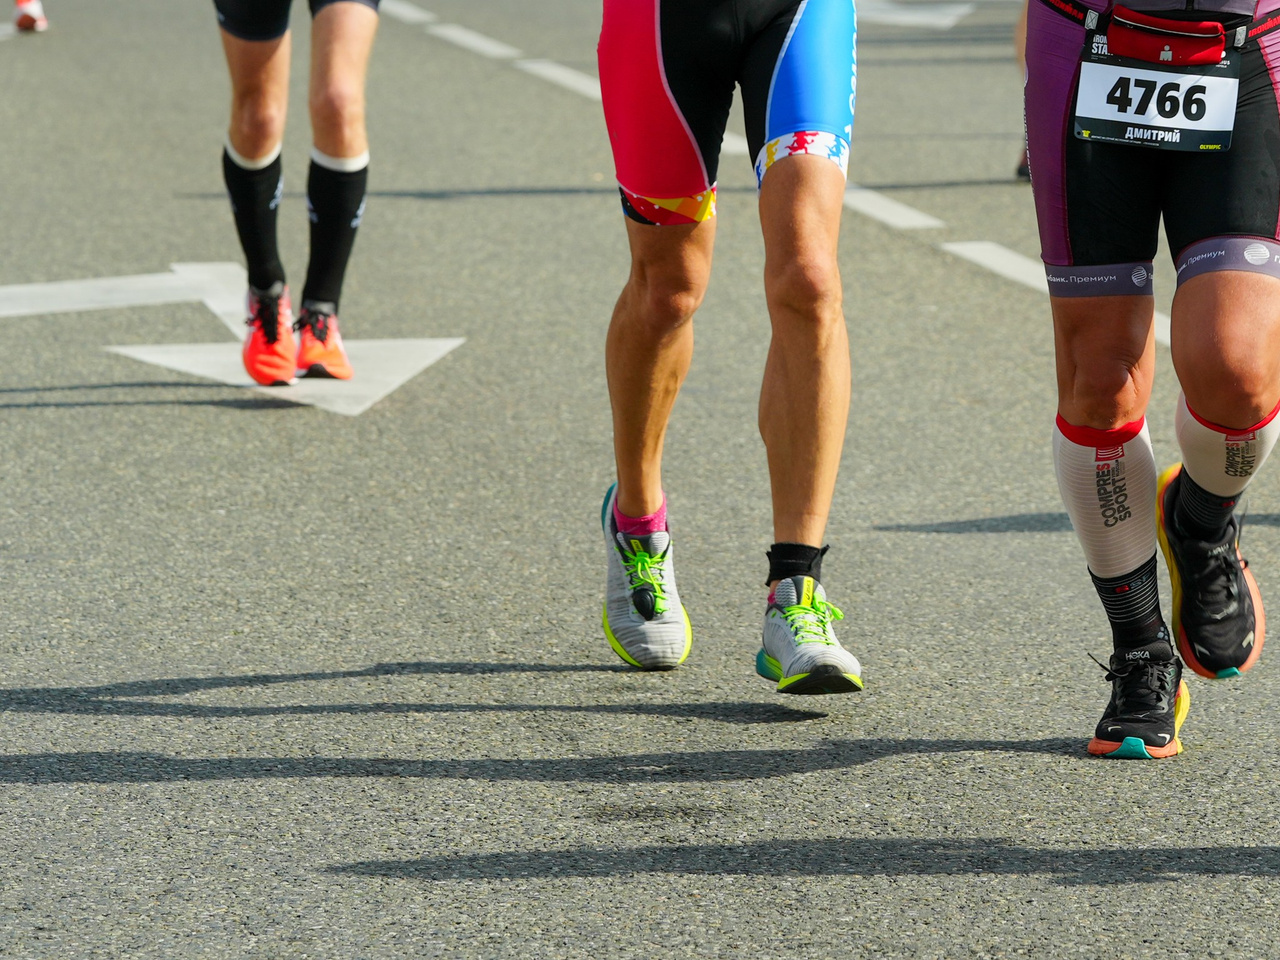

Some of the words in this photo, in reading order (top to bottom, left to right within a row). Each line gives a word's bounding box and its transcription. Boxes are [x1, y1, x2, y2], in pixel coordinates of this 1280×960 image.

[1091, 43, 1114, 56] STA
[1106, 76, 1207, 122] 4766
[1125, 127, 1181, 143] ДМИТРИЙ
[1187, 250, 1225, 266] Премиум
[1069, 275, 1117, 284] Премиум
[1095, 463, 1119, 528] COMPRES
[1111, 477, 1132, 522] SPORT
[1125, 650, 1151, 661] HOKA
